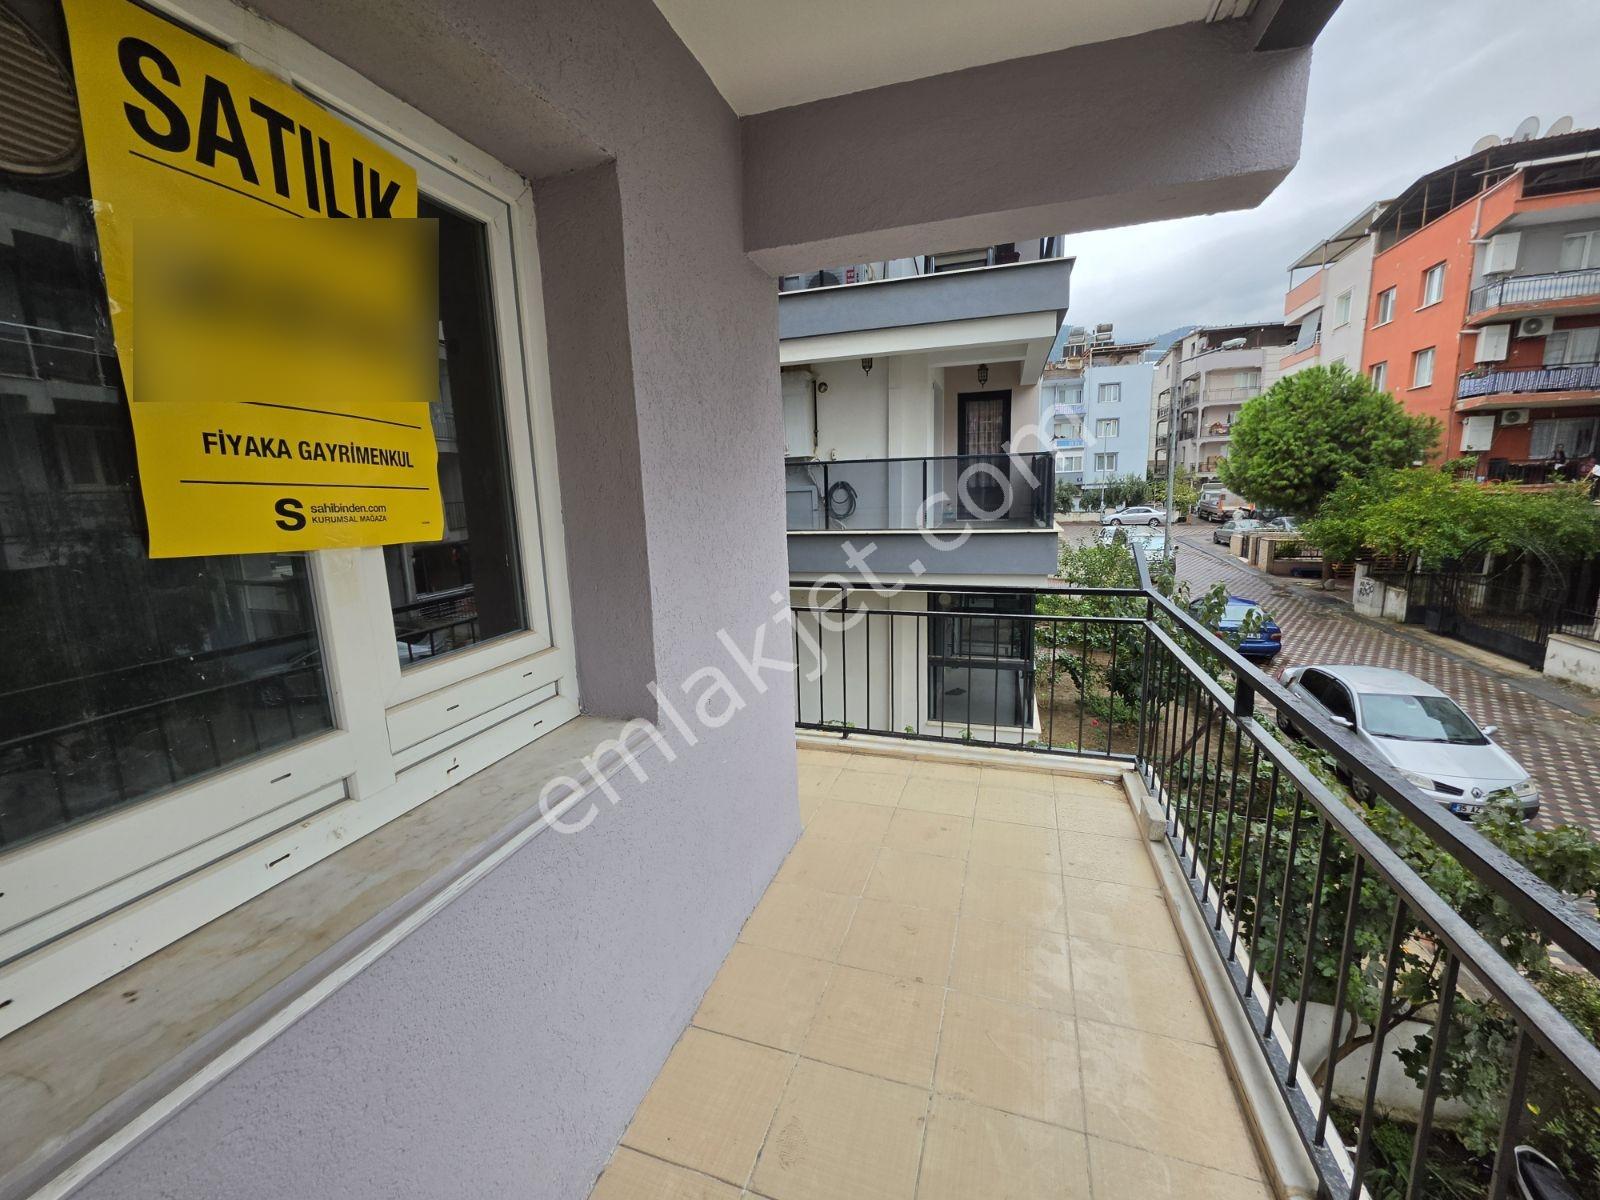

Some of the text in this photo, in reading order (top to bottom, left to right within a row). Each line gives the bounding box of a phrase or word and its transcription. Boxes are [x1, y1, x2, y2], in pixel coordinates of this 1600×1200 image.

[117, 36, 401, 219] SATILIK
[202, 429, 414, 468] FİYAKA GAYRİMENKUL
[310, 503, 386, 513] sahibinden.com
[311, 515, 359, 524] KURUMSAL
